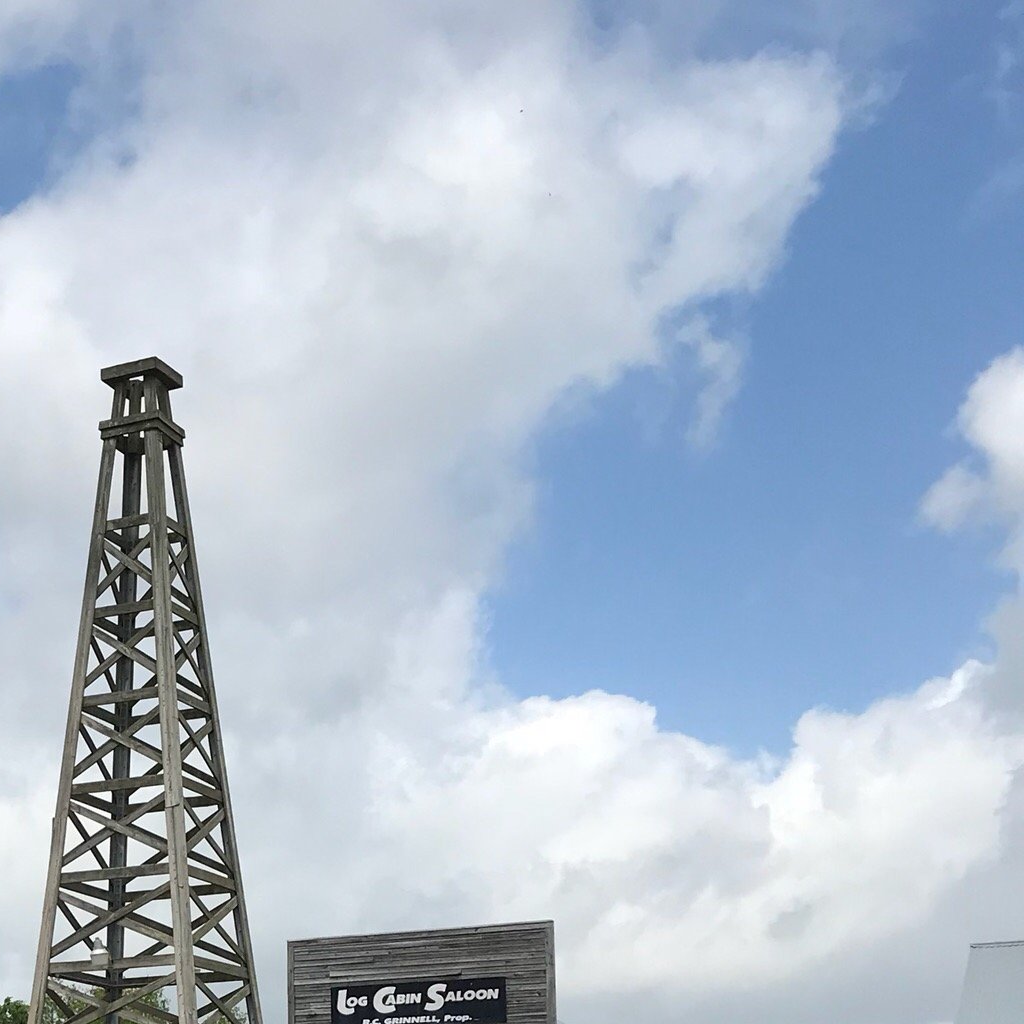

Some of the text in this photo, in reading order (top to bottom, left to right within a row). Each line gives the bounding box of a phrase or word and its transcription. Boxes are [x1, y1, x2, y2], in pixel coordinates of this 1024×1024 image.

[337, 983, 499, 1015] LOG CABIN SALOON
[384, 1015, 441, 1024] GRINNELL,
[444, 1014, 473, 1023] Prop.
